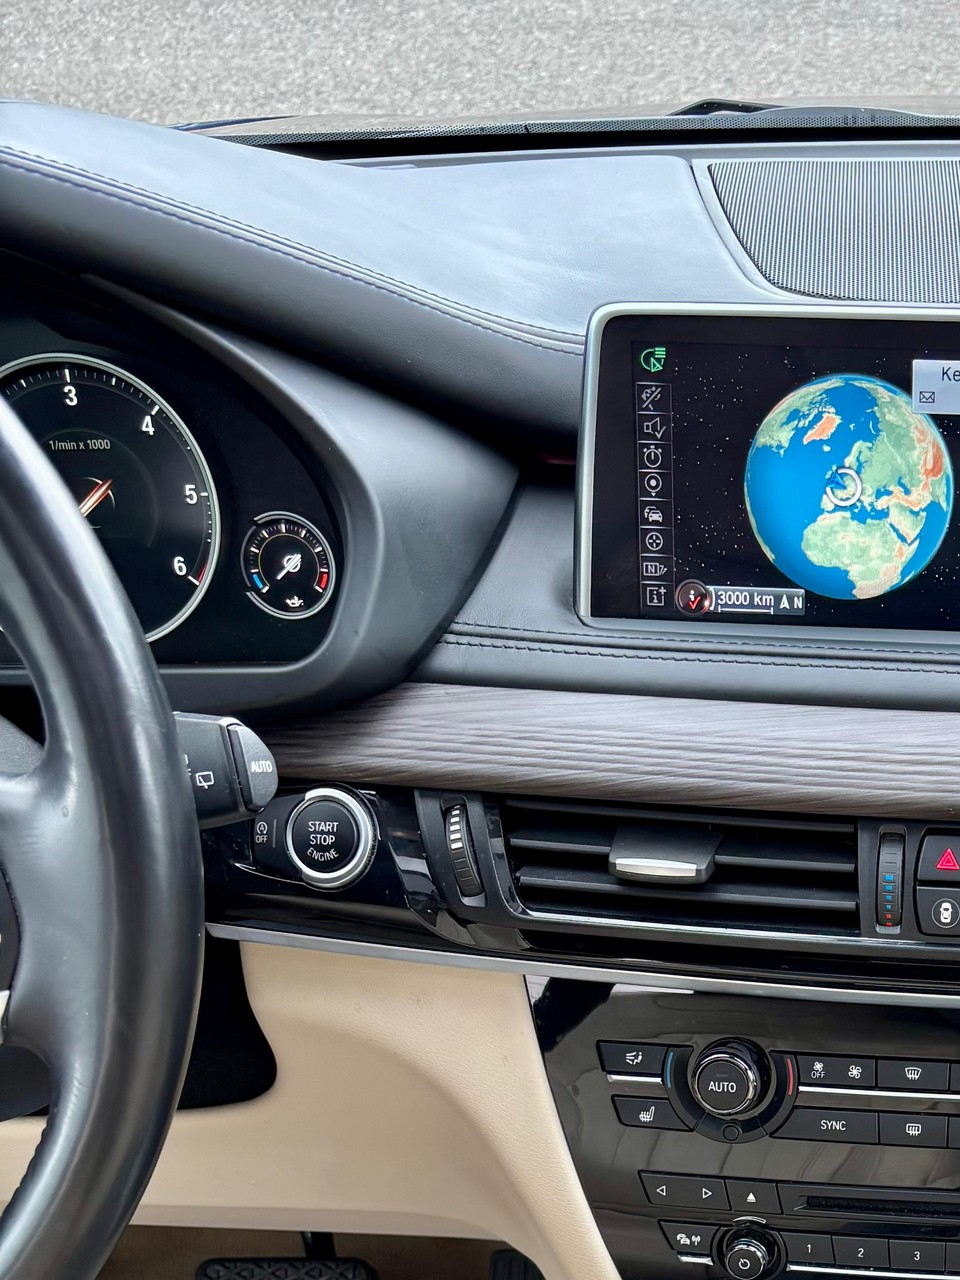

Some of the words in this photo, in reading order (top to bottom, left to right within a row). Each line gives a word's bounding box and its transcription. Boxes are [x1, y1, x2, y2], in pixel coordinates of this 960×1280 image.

[64, 386, 78, 407] 3
[141, 416, 155, 436] 4
[49, 440, 77, 451] 1/min
[87, 438, 111, 450] 1000
[184, 485, 198, 505] 5
[173, 556, 187, 575] 6
[718, 591, 749, 605] 3000
[754, 592, 774, 606] km
[793, 597, 802, 608] N
[251, 761, 272, 772] AUTO
[308, 821, 339, 832] START
[256, 835, 268, 843] OFF
[310, 834, 335, 845] STOP
[307, 847, 339, 861] ENGINE
[811, 1071, 825, 1079] OFF
[708, 1081, 737, 1093] AUTO
[821, 1120, 846, 1131] SYNC
[807, 1244, 812, 1253] 1
[858, 1248, 864, 1258] 2
[914, 1251, 920, 1261] 3
